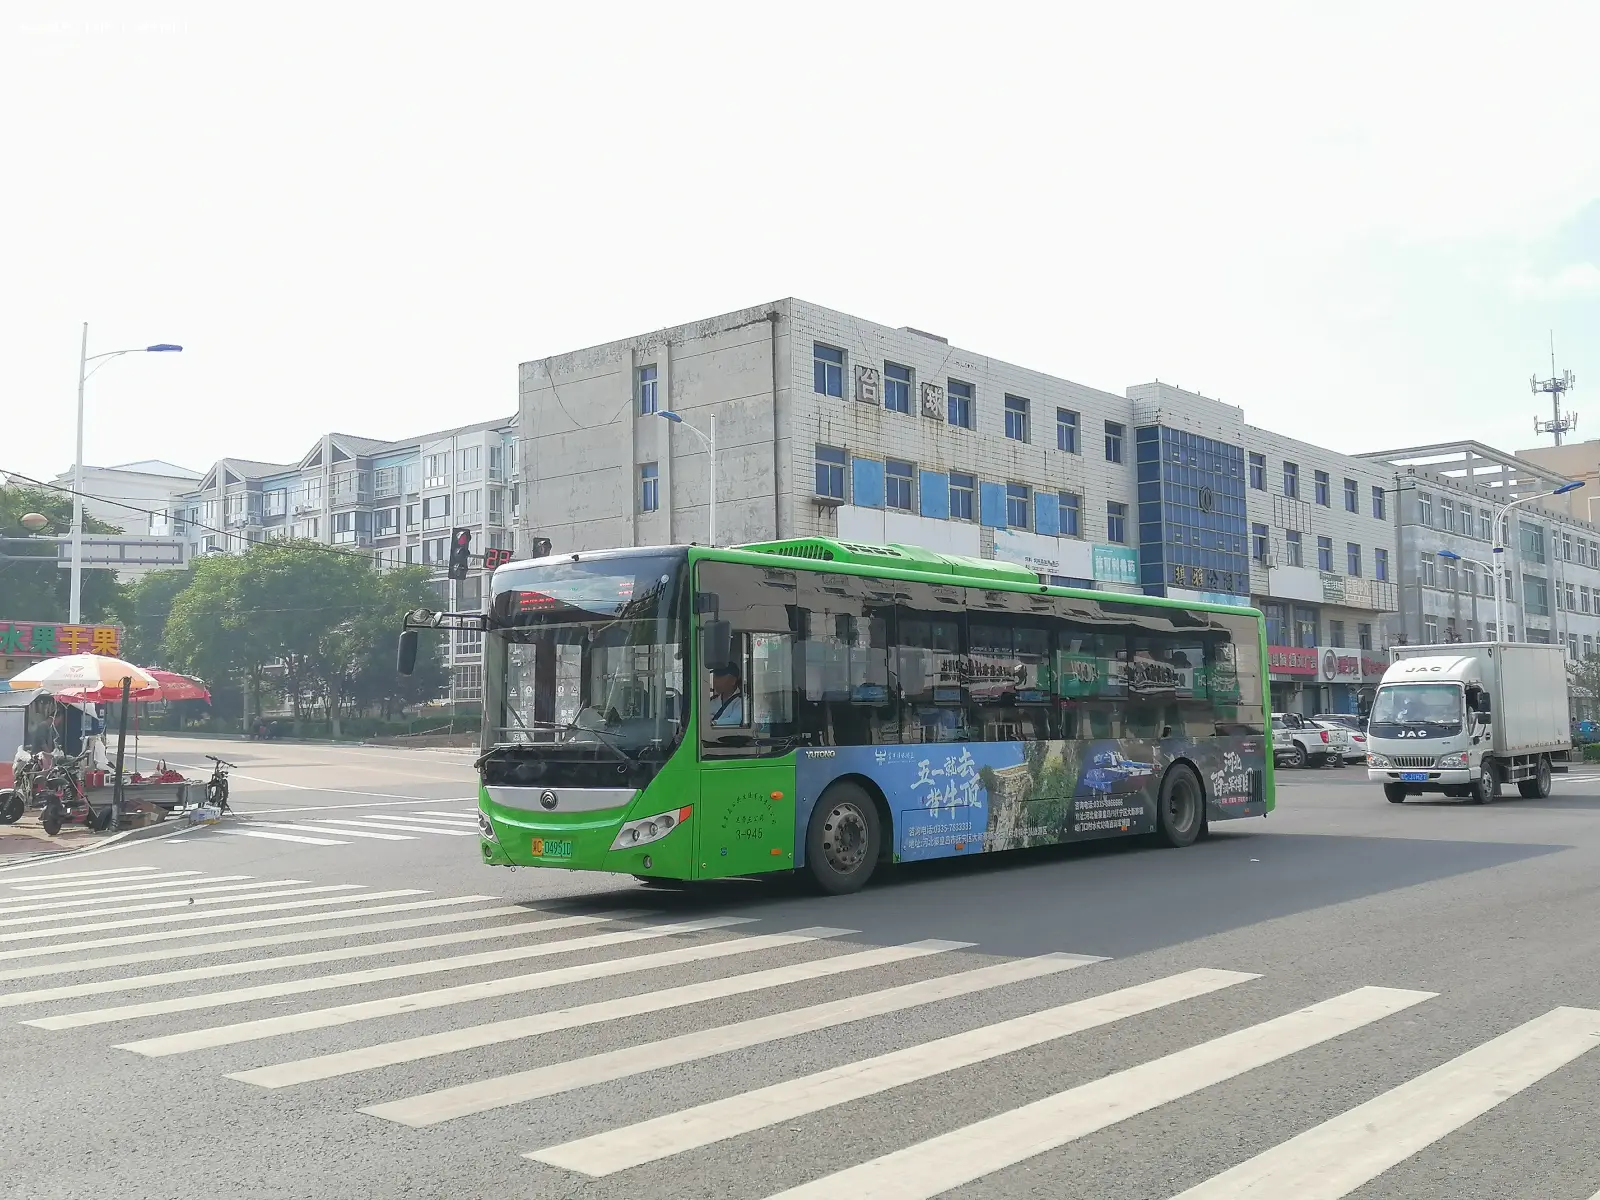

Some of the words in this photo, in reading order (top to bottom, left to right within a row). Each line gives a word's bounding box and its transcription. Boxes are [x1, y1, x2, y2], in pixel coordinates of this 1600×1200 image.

[0, 624, 119, 655] 水果干果
[1397, 730, 1427, 738] JAC
[805, 750, 836, 759] YUTONG
[735, 827, 763, 840] 3-945
